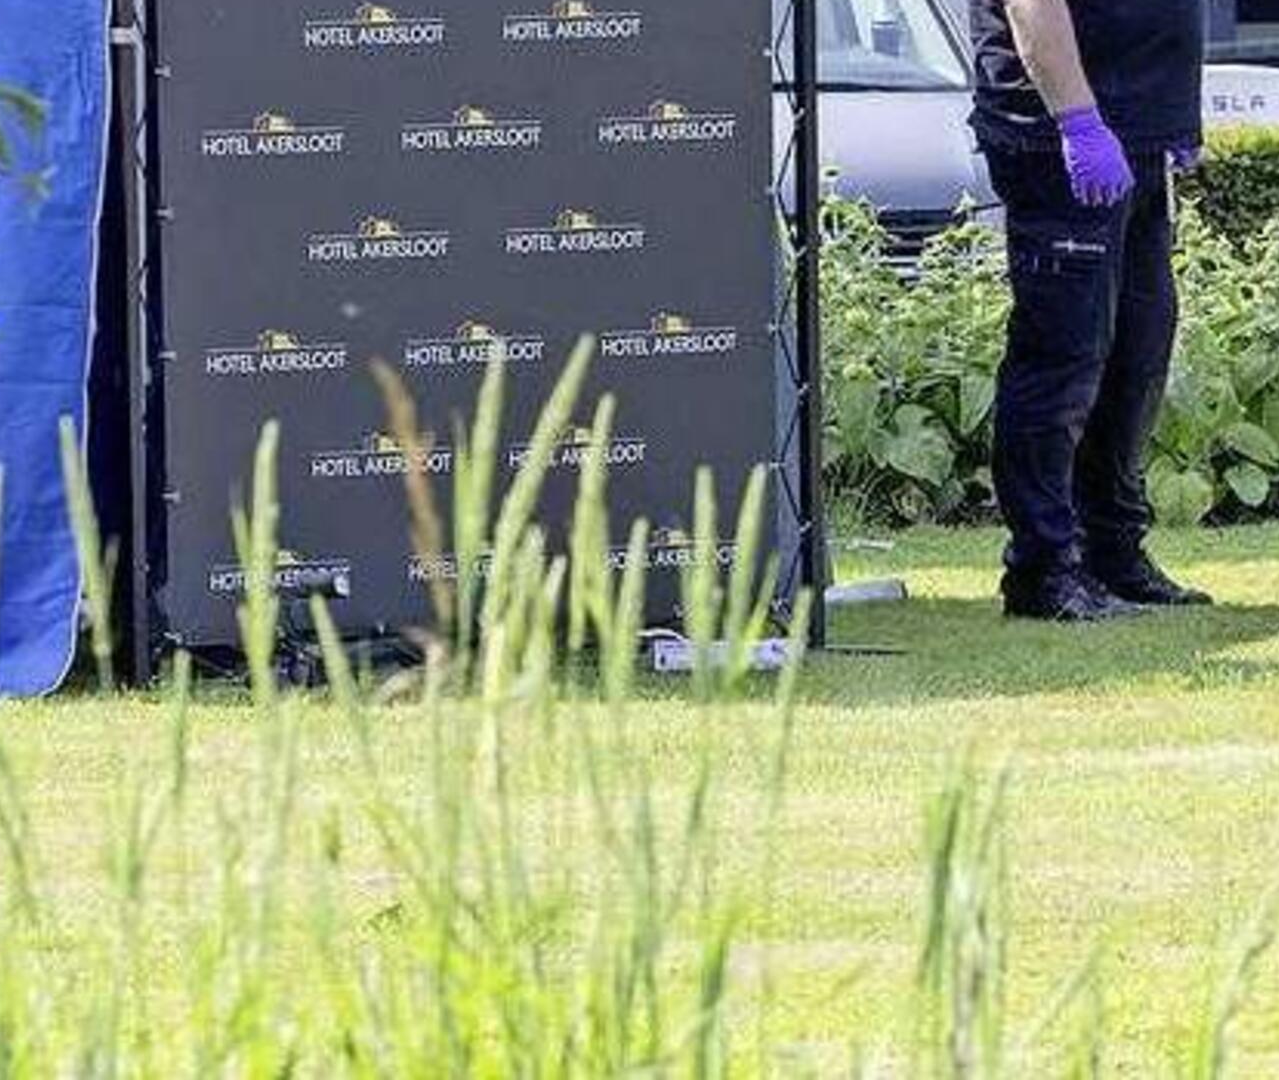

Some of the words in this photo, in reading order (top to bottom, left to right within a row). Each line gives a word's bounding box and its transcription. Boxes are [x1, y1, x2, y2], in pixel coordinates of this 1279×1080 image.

[305, 27, 354, 47] HOTEL
[357, 23, 445, 45] AKERSLOOT
[503, 21, 552, 40] HOTEL
[556, 18, 642, 39] AKERSLOOT
[1212, 94, 1266, 112] SLA
[402, 130, 452, 149] HOTEL
[454, 127, 542, 147] AKERSLOOT
[598, 124, 646, 143] HOTEL
[652, 120, 736, 141] AKERSLOOT
[202, 136, 252, 155] HOTEL
[256, 132, 344, 154] AKERSLOOT
[308, 241, 359, 261] HOTEL
[361, 238, 449, 258] AKERSLOOT
[506, 233, 556, 253] HOTEL
[559, 230, 644, 250] AKERSLOOT
[405, 345, 455, 365] HOTEL
[601, 338, 650, 358] HOTEL
[652, 333, 737, 354] AKERSLOOT
[206, 354, 256, 374] HOTEL
[259, 351, 347, 371] AKERSLOOT
[311, 458, 362, 477] HOTEL
